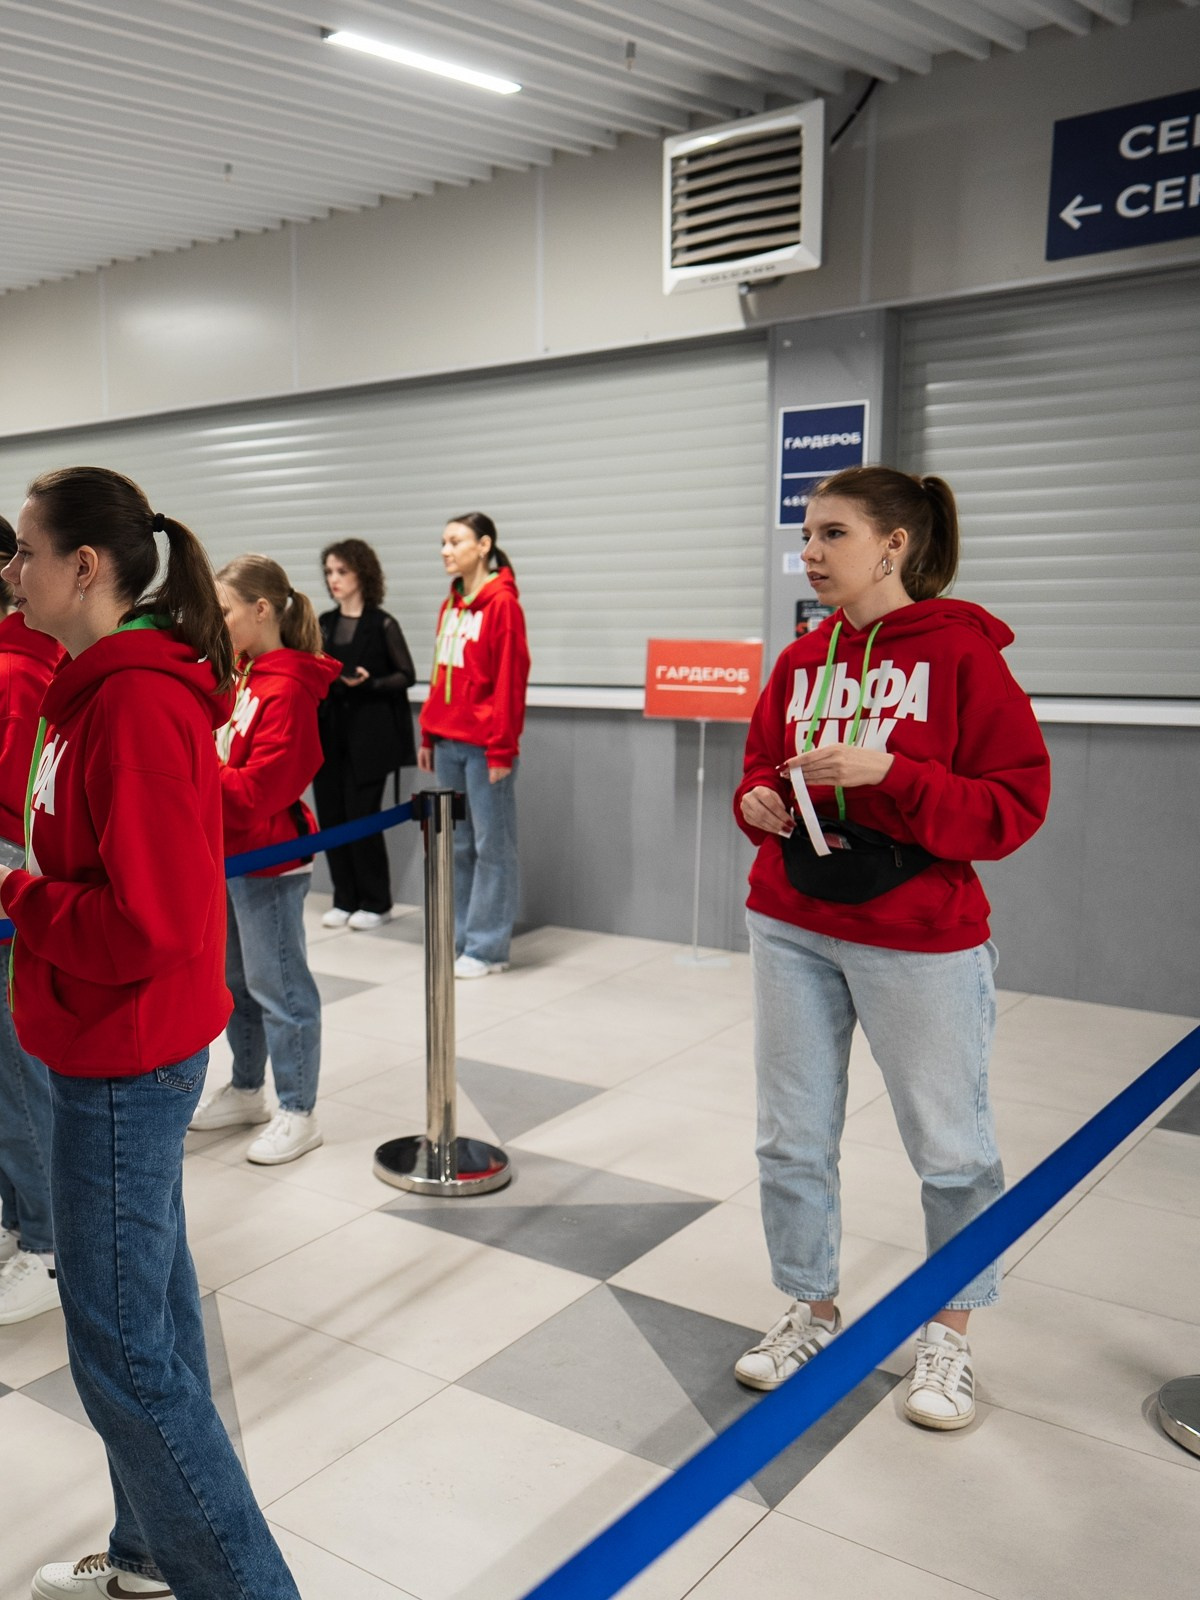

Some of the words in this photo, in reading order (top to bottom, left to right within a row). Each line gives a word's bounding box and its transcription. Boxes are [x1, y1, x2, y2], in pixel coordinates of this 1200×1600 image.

[1119, 112, 1200, 160] СЕ
[784, 431, 862, 450] ГАРДЕРОБ
[656, 665, 750, 683] ГАРДЕРОБ
[786, 659, 930, 724] АЛЬФА
